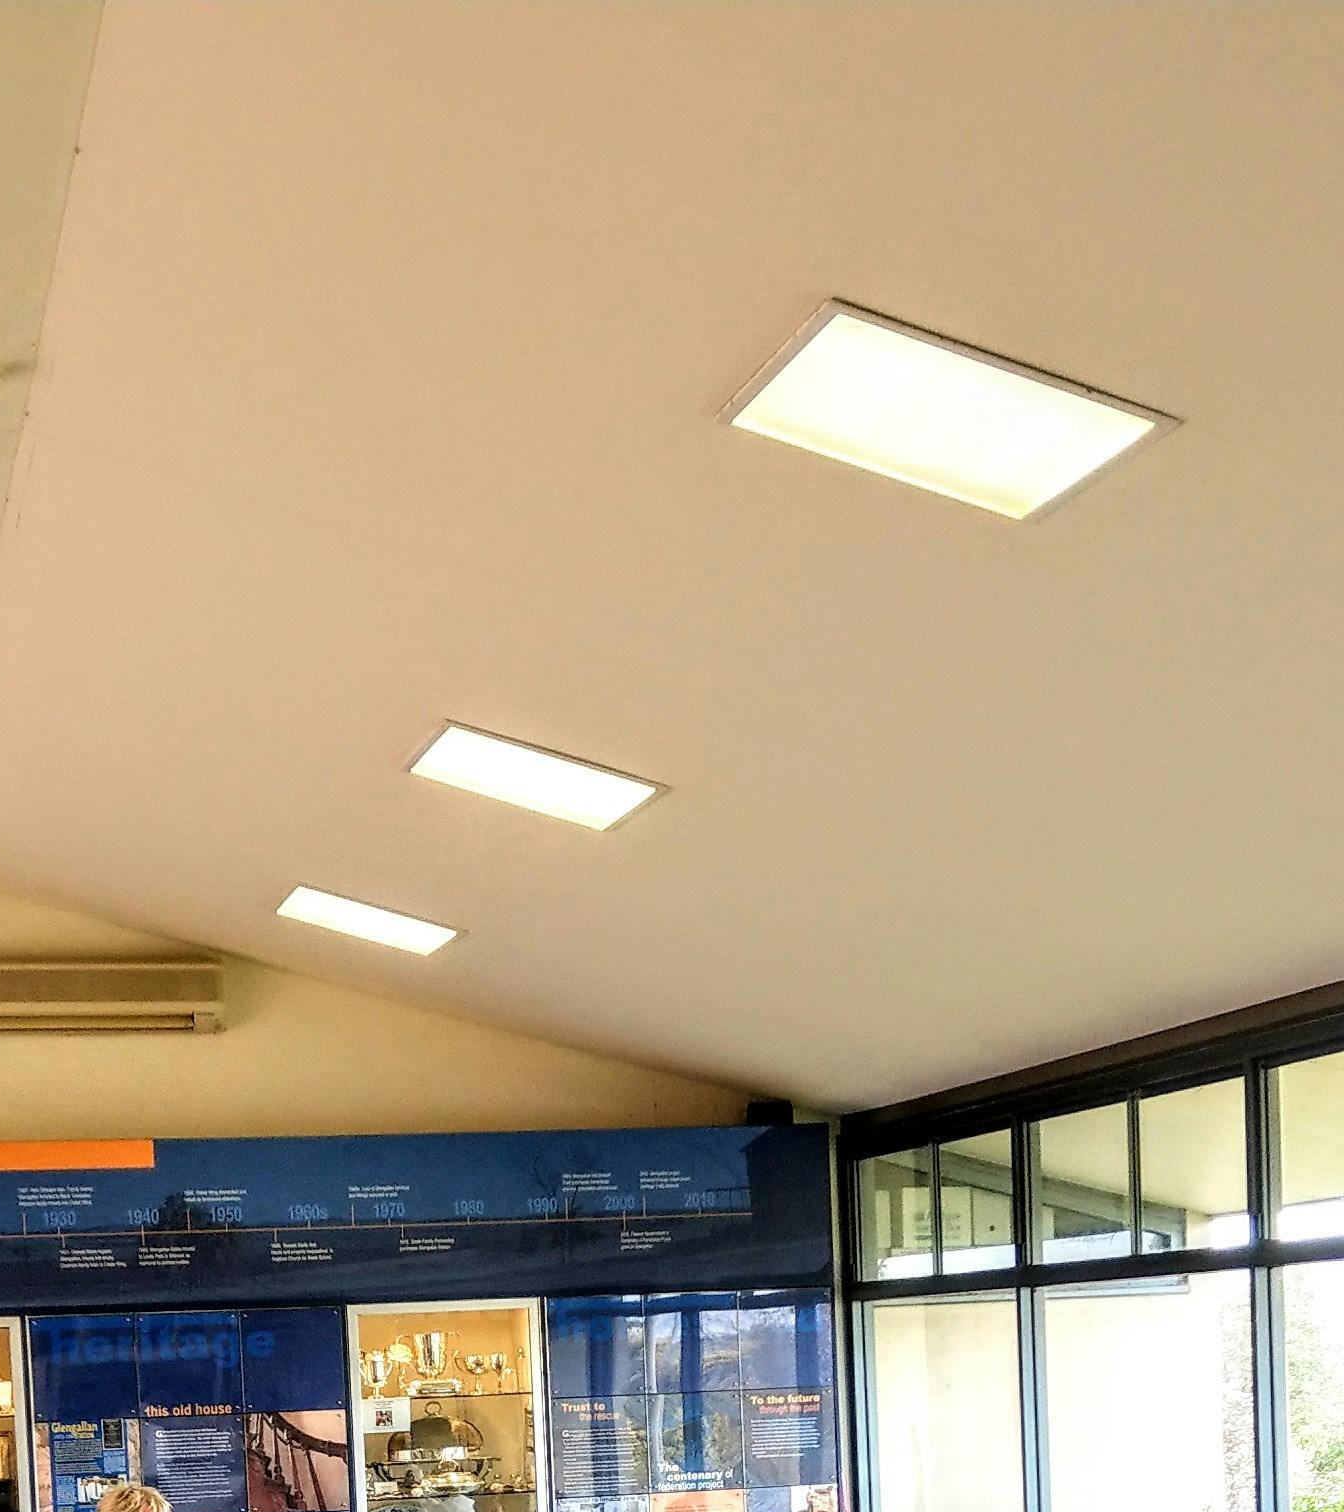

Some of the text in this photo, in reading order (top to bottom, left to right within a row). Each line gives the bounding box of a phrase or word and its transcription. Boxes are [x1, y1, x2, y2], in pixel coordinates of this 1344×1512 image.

[453, 1200, 485, 1215] 1980
[526, 1197, 557, 1213] 1990
[605, 1195, 635, 1210] 2000
[684, 1192, 715, 1208] 2010
[127, 1208, 159, 1224] 1940
[209, 1205, 243, 1222] 1950
[288, 1203, 328, 1220] 1960s
[373, 1201, 405, 1218] 1970
[44, 1210, 76, 1226] 1930
[751, 1393, 820, 1404] To the future
[145, 1403, 232, 1417] this old house
[561, 1402, 605, 1412] Trust to
[657, 1462, 679, 1472] The
[667, 1469, 733, 1481] centenary of
[657, 1480, 724, 1491] federation project
